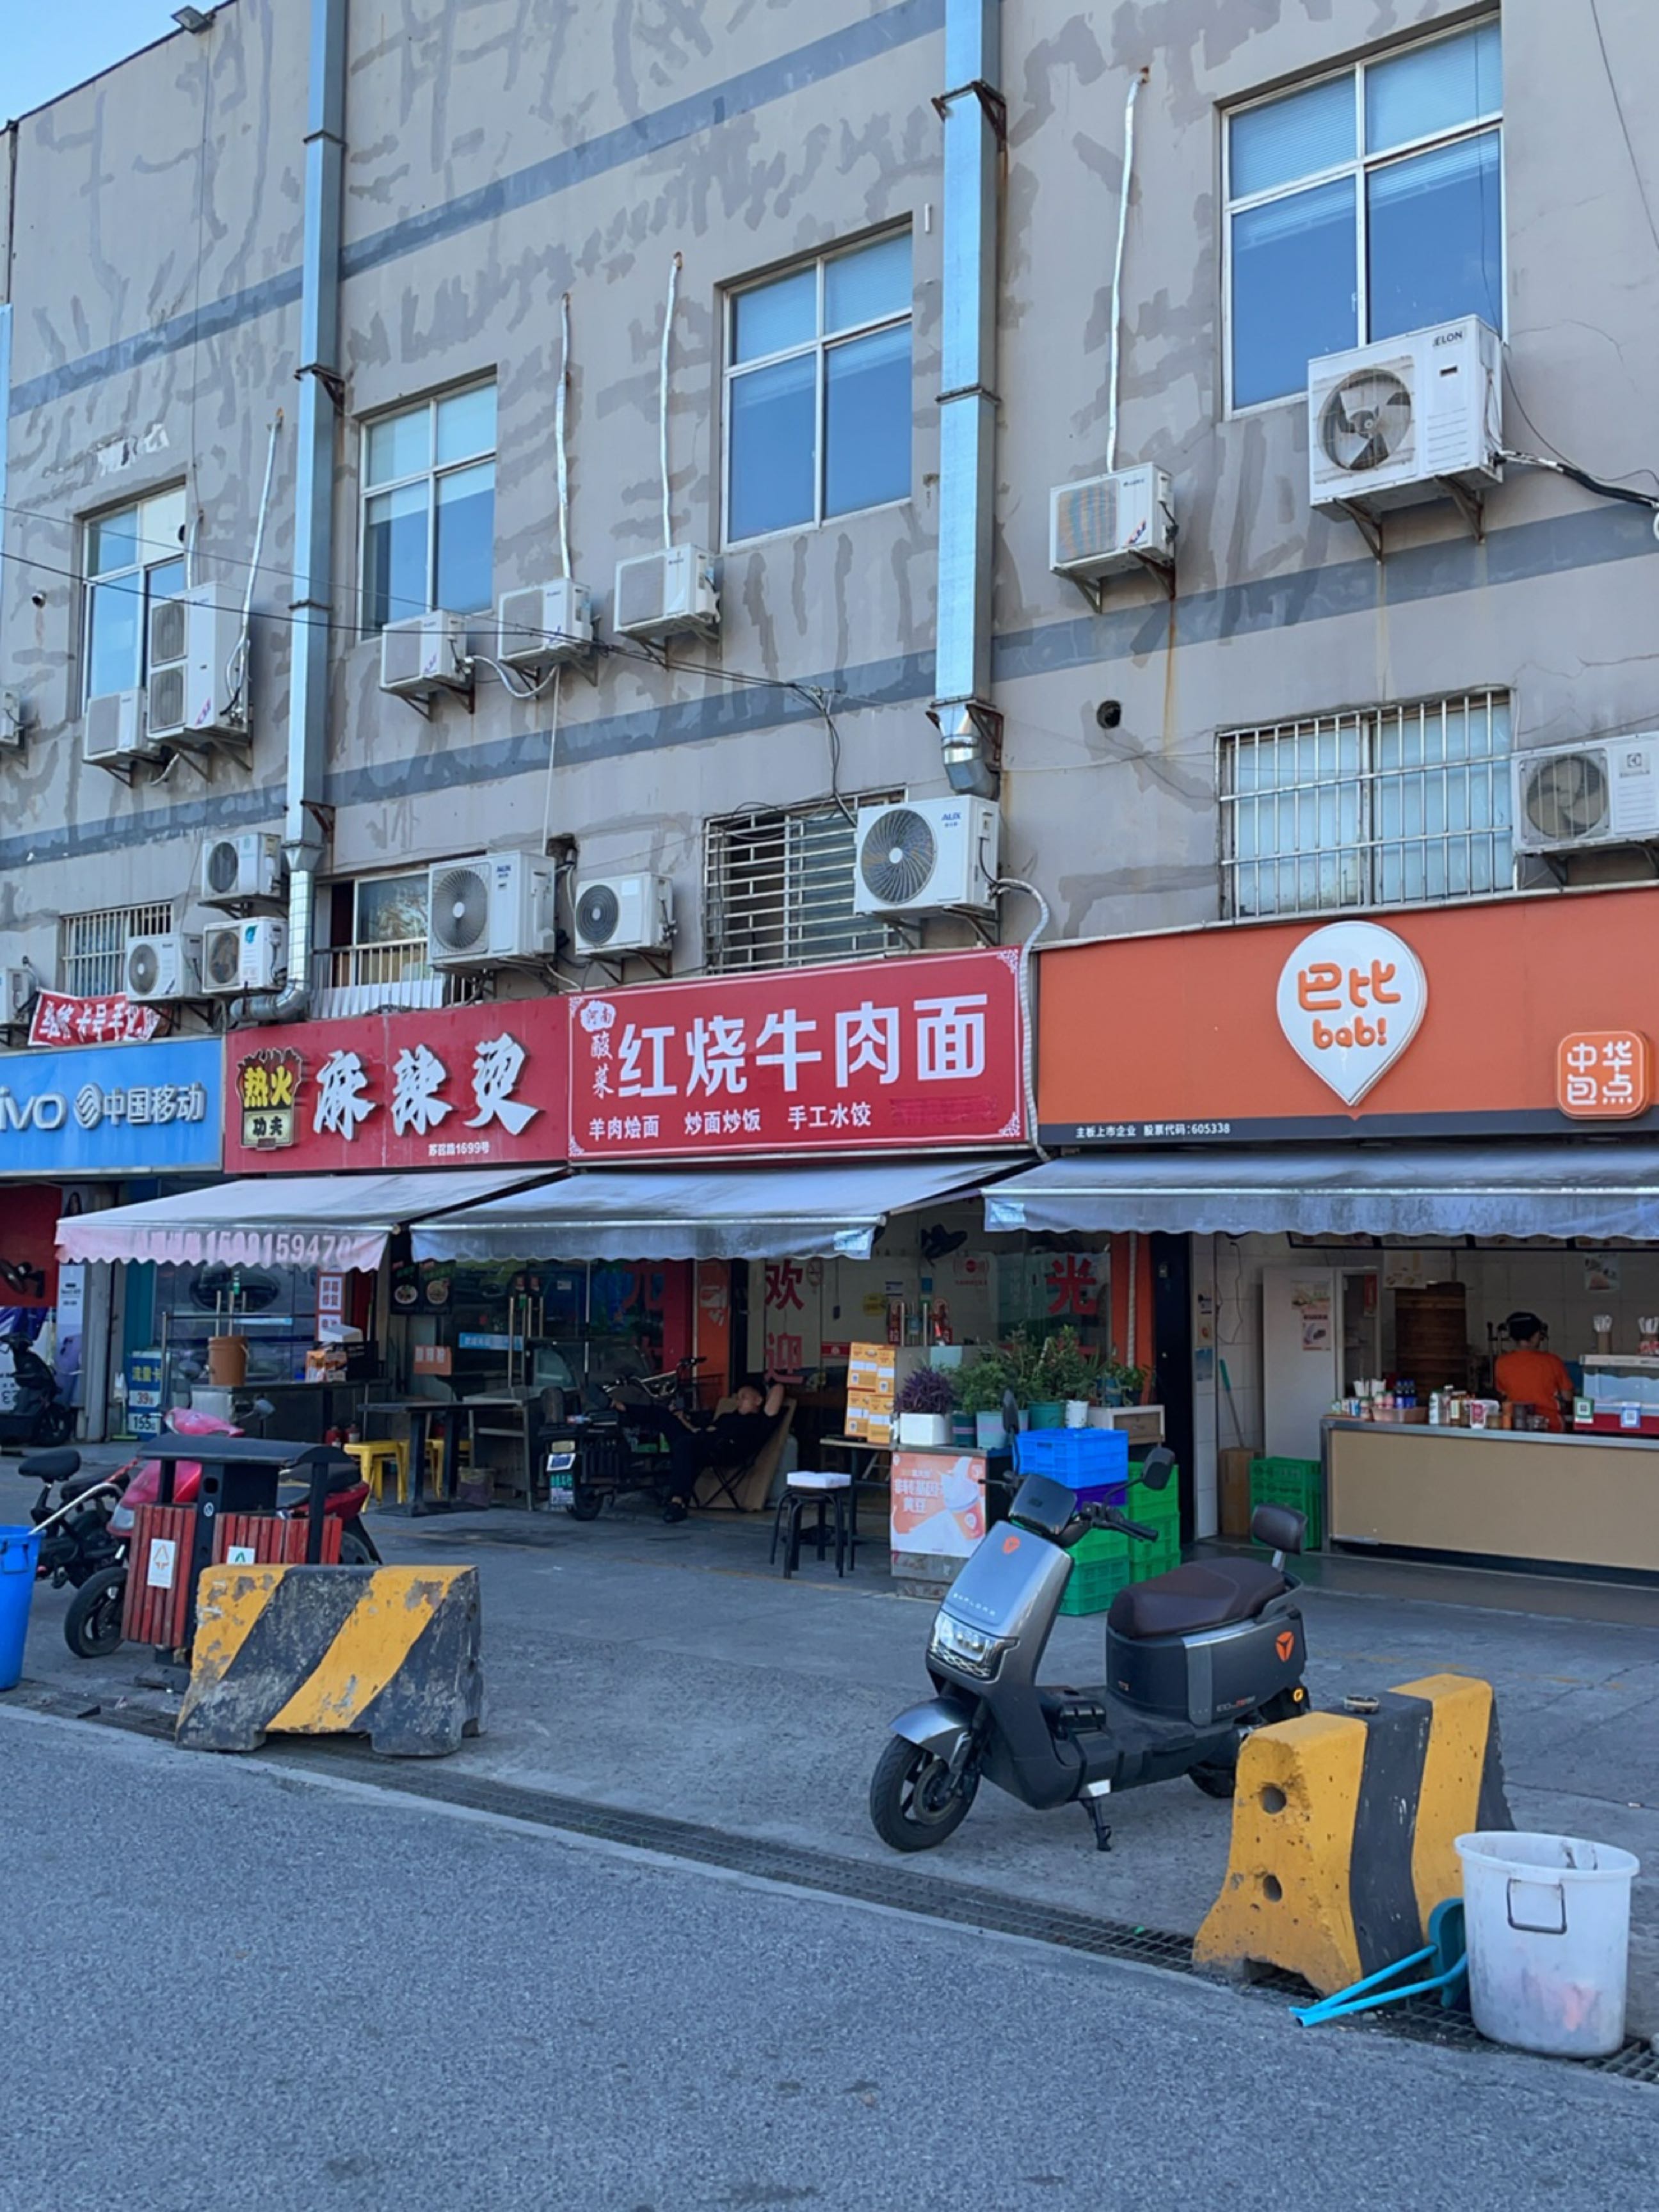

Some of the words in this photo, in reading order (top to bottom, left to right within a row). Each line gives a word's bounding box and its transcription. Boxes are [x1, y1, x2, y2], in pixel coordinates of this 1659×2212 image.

[1298, 959, 1400, 1012] 巴比
[586, 1006, 612, 1025] 河南
[591, 1030, 614, 1100] 酸菜
[618, 993, 989, 1098] 红烧牛肉面
[1567, 1041, 1632, 1073] 中华
[104, 1083, 205, 1125] 中国移动
[244, 1066, 293, 1108] 热火
[313, 1032, 540, 1141] 麻辣烫
[1567, 1074, 1633, 1105] 包点
[253, 1116, 283, 1136] 功夫
[589, 1114, 660, 1141] 羊肉烩面
[684, 1109, 762, 1135] 炒面炒饭
[788, 1102, 872, 1130] 手工水饺
[1075, 1125, 1137, 1139] 主板上市企业
[1144, 1123, 1231, 1137] 股票代码:605338
[1046, 1254, 1098, 1315] 光
[765, 1259, 805, 1384] 欢迎
